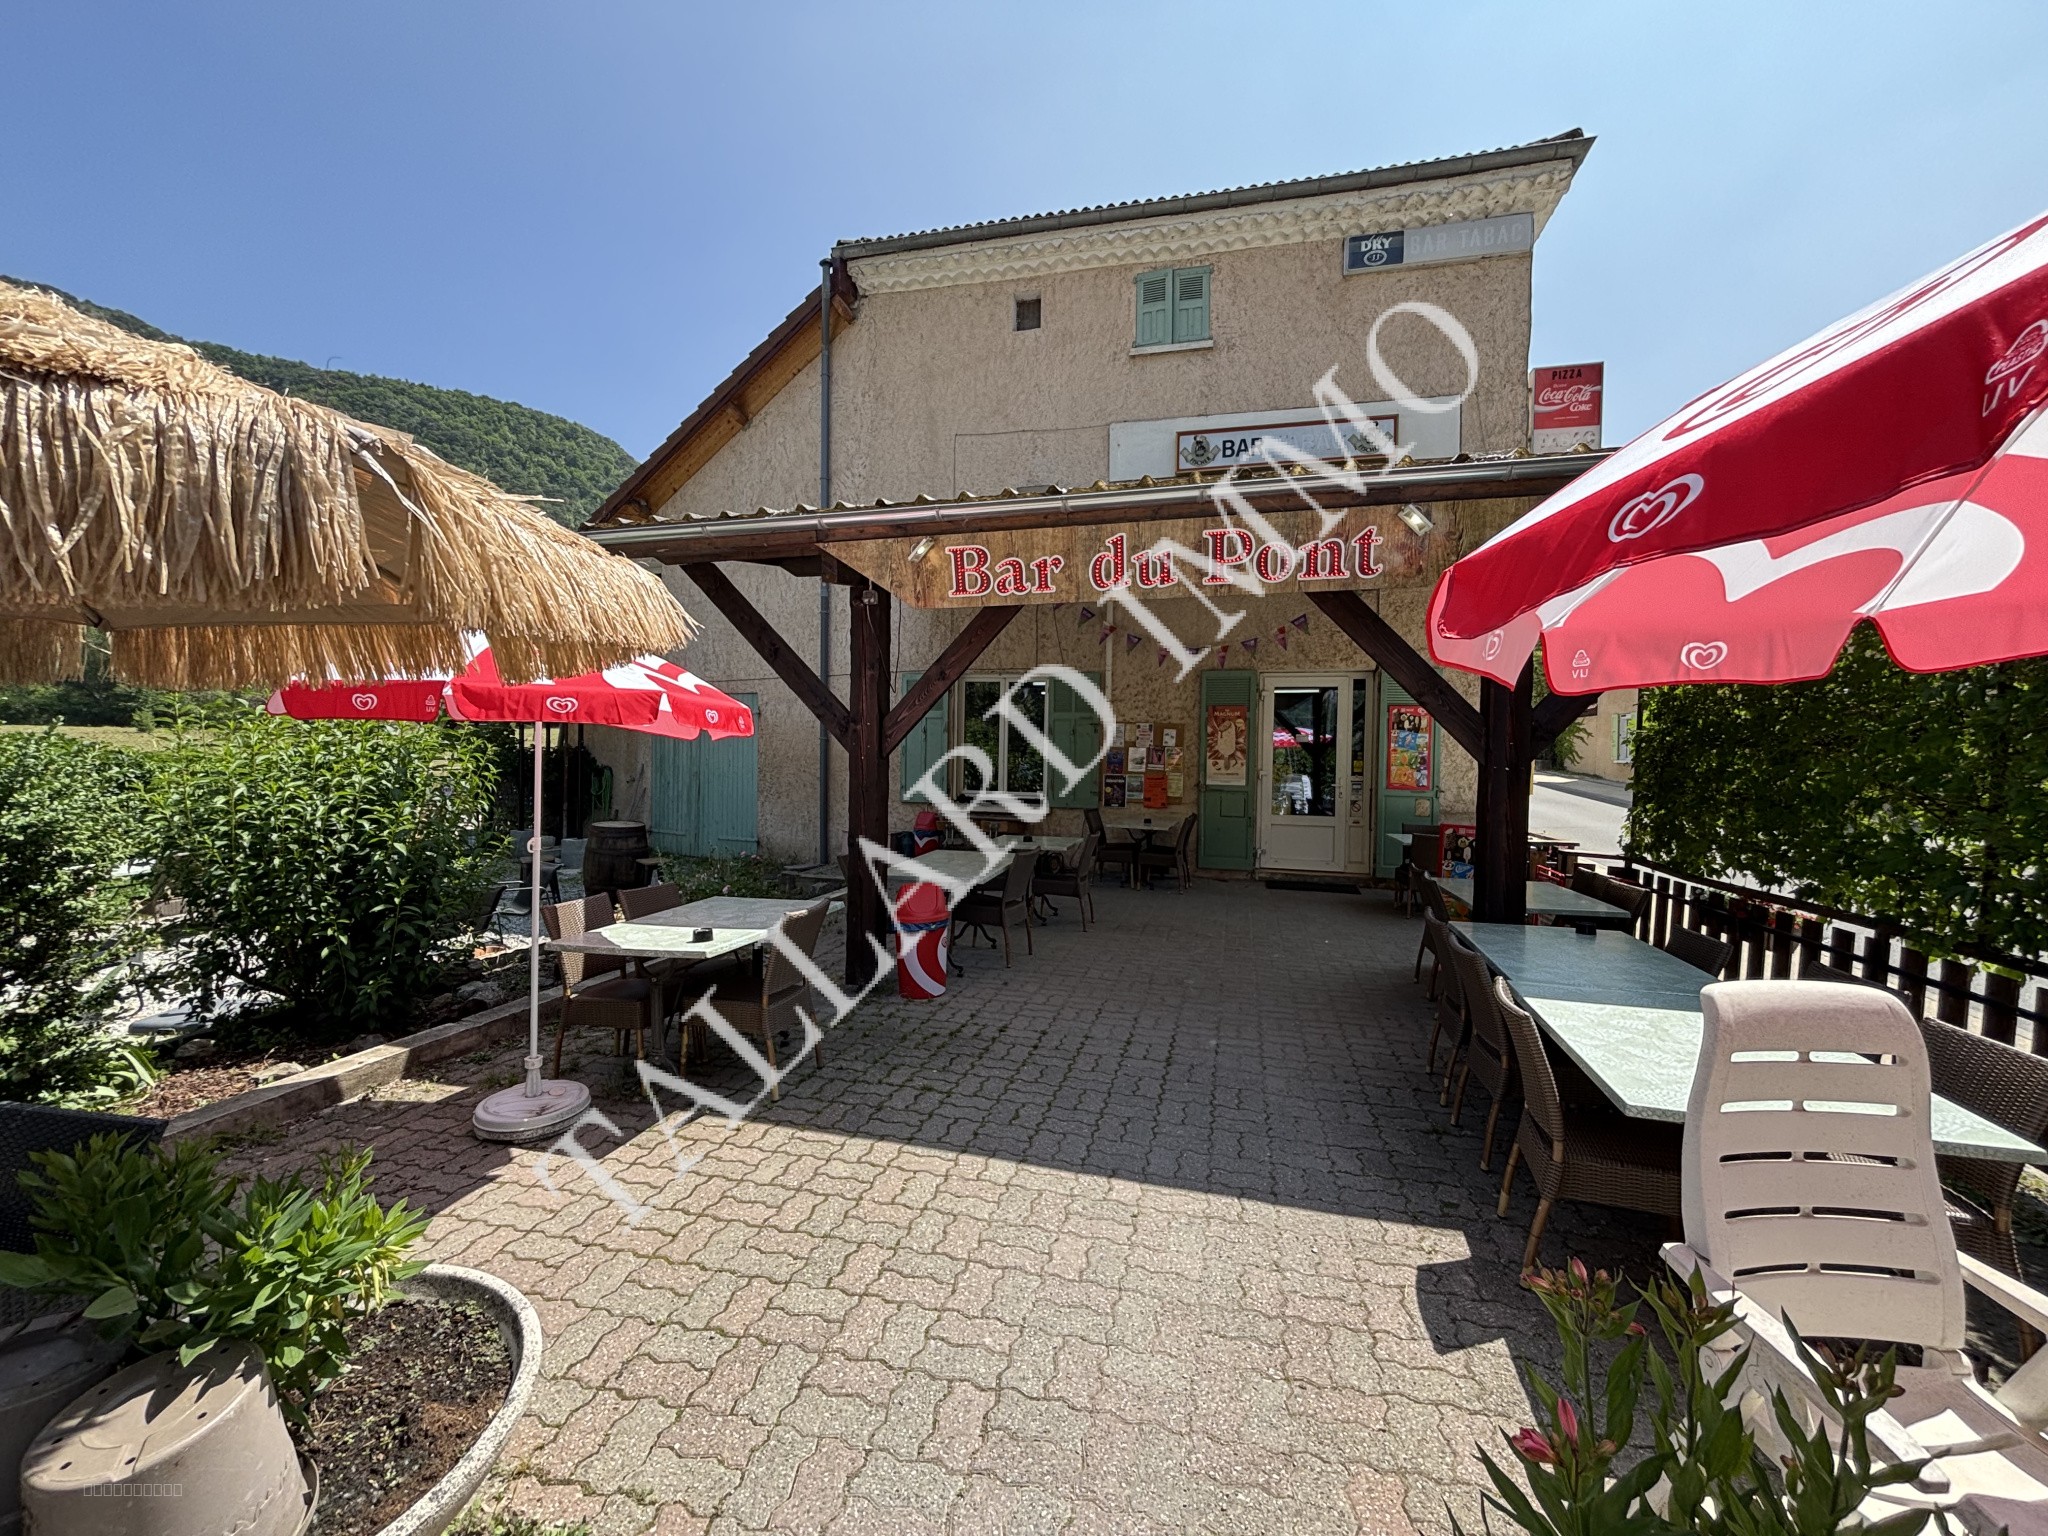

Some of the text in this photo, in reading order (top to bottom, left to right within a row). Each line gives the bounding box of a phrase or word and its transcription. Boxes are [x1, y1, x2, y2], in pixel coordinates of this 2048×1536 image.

[1360, 234, 1393, 252] DRY
[1410, 223, 1523, 253] BAR TABAC
[1552, 368, 1583, 380] PIZZA
[1538, 384, 1593, 405] Coca-Cola
[1982, 364, 2037, 418] UV
[1569, 402, 1593, 412] Coke
[945, 526, 1385, 598] Bar du Pont
